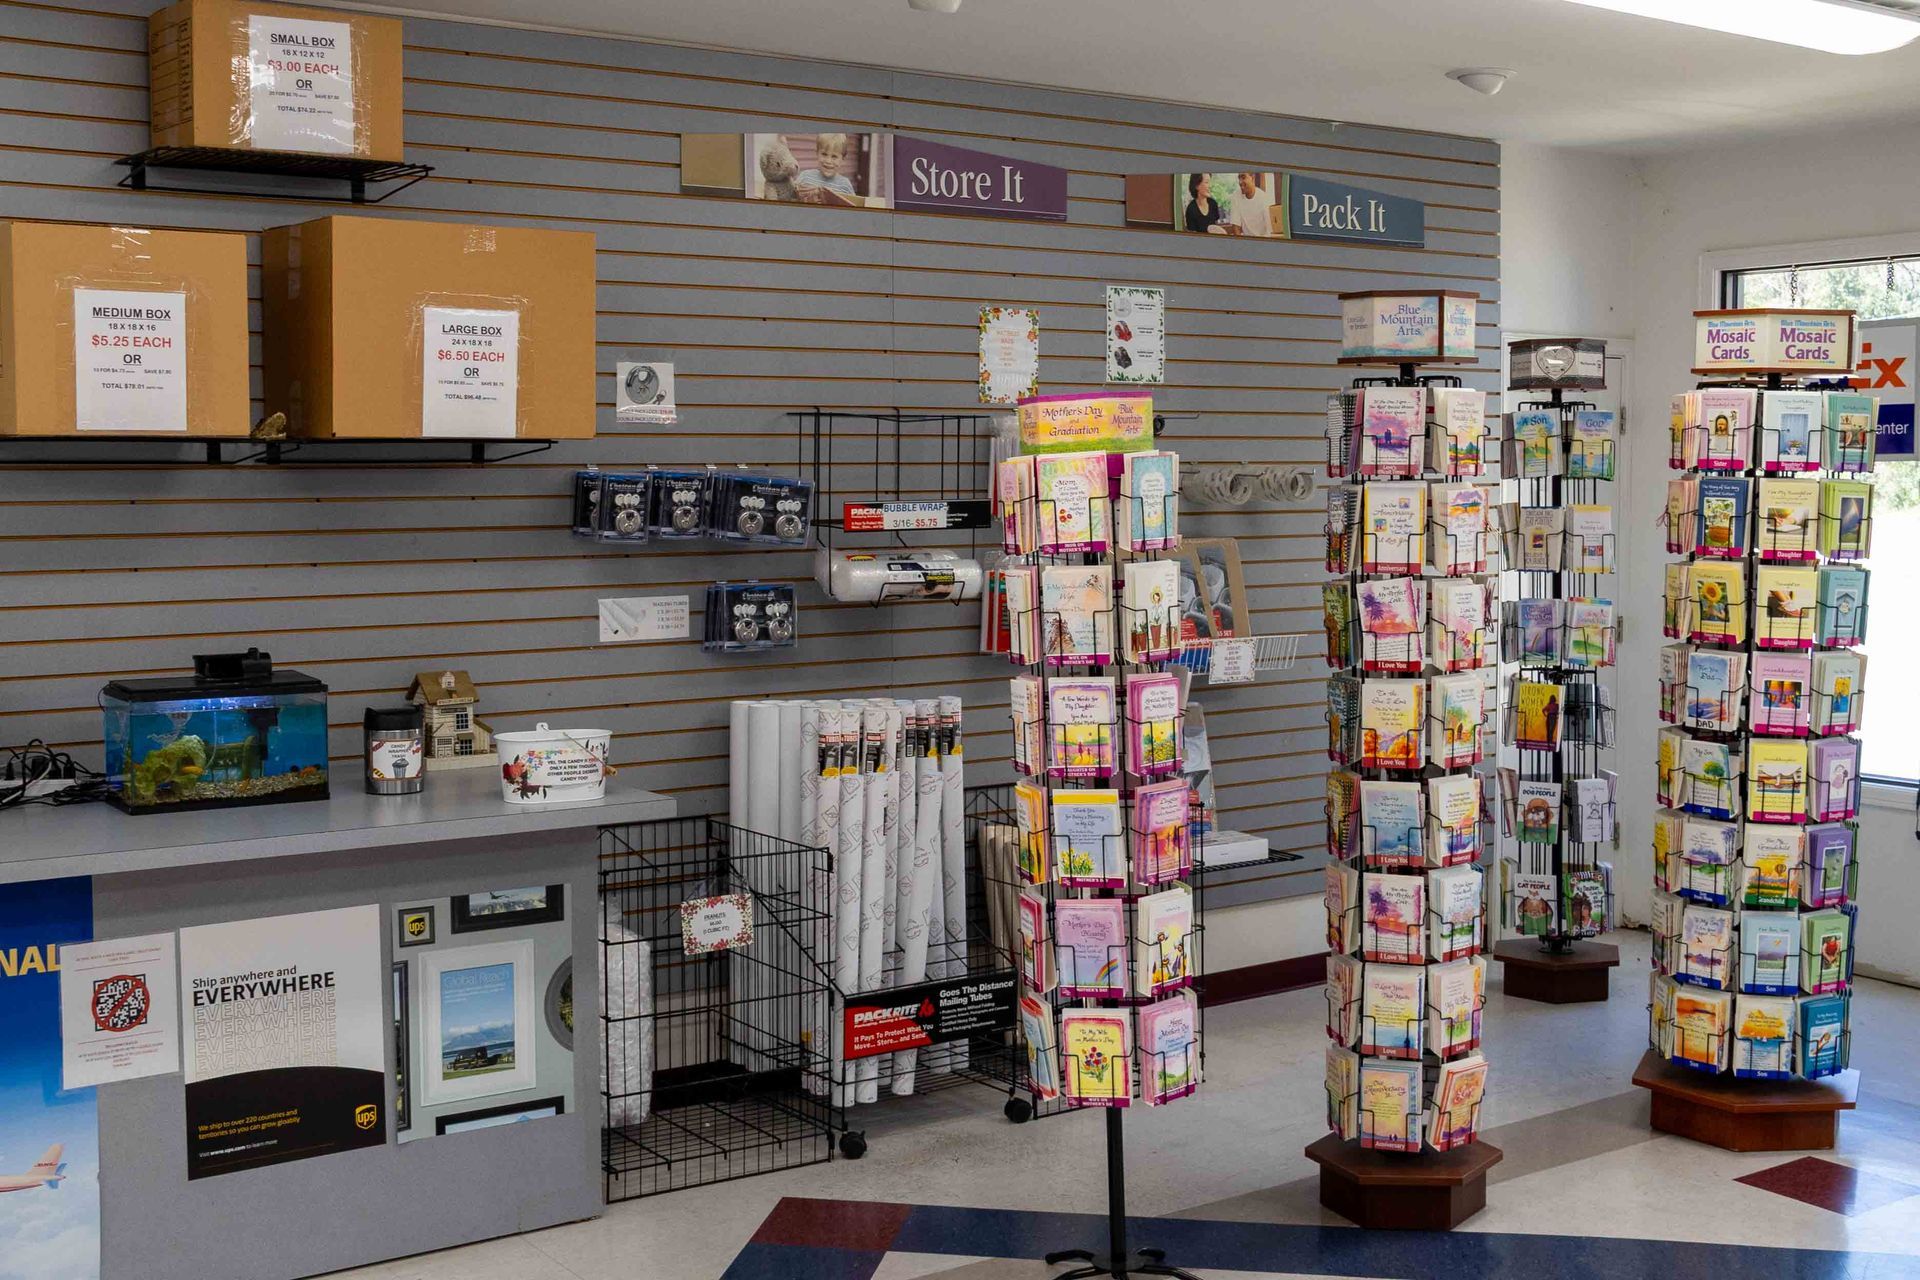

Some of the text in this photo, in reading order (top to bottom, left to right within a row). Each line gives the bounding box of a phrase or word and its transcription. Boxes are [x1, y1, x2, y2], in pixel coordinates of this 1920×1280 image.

[270, 33, 335, 48] SMALL BOX
[299, 50, 309, 58] 12
[304, 63, 339, 75] EACH
[295, 79, 313, 89] OR
[911, 157, 1025, 204] Store It
[1302, 193, 1388, 233] Pack It
[92, 307, 171, 319] MEDIUM BOX
[1397, 304, 1421, 315] Blue
[1380, 314, 1434, 327] Mountain
[1720, 320, 1744, 328] Mountain
[1781, 319, 1794, 327] Blue
[1795, 320, 1823, 328] Mountain
[442, 325, 502, 336] LARGE BOX
[1396, 326, 1421, 336] Arts
[1706, 328, 1756, 344] Mosaic
[1780, 327, 1836, 344] Mosaic
[91, 334, 172, 348] $5.25 EACH
[437, 349, 505, 362] $6.50 EACH
[1711, 345, 1750, 360] Cards
[1784, 345, 1829, 360] Cards
[123, 354, 142, 364] OR
[463, 367, 480, 377] OR
[1042, 406, 1103, 421] Mother's Day
[1119, 403, 1134, 414] Blue
[1112, 414, 1143, 427] Mountain
[1049, 426, 1100, 437] Graduation
[1875, 423, 1910, 435] enter
[883, 504, 917, 513] BUBBLE
[915, 518, 938, 527] $5.75
[1776, 551, 1802, 559] Daughter
[1773, 639, 1798, 647] Daughter
[1521, 685, 1545, 696] STRONG
[1697, 720, 1714, 729] DAD
[1702, 806, 1712, 814] Son
[704, 912, 726, 920] PEANUTS
[408, 922, 425, 933] ups
[192, 965, 298, 989] Ship anywhere and
[443, 969, 511, 988] Global Reach
[193, 971, 336, 1007] EVERYWHERE
[939, 980, 1014, 998] Goes The Distance
[939, 992, 993, 1007] Mailing Tubes
[194, 988, 337, 1025] EVERYWHERE
[860, 1033, 874, 1042] Pays
[884, 1027, 906, 1037] Protect
[922, 1023, 934, 1031] You
[854, 1032, 927, 1051] Move... Store... and Send
[1689, 1060, 1699, 1068] Son
[1364, 1084, 1407, 1098] Anniversary
[209, 1123, 223, 1131] ship
[245, 1116, 258, 1124] 220
[258, 1113, 285, 1122] countries
[285, 1109, 298, 1117] and
[357, 1110, 376, 1125] ups
[198, 1130, 229, 1140] territories
[237, 1126, 249, 1135] you
[261, 1121, 277, 1130] grow
[210, 1145, 246, 1156] www.ups.com
[1375, 1141, 1405, 1149] Anniversary
